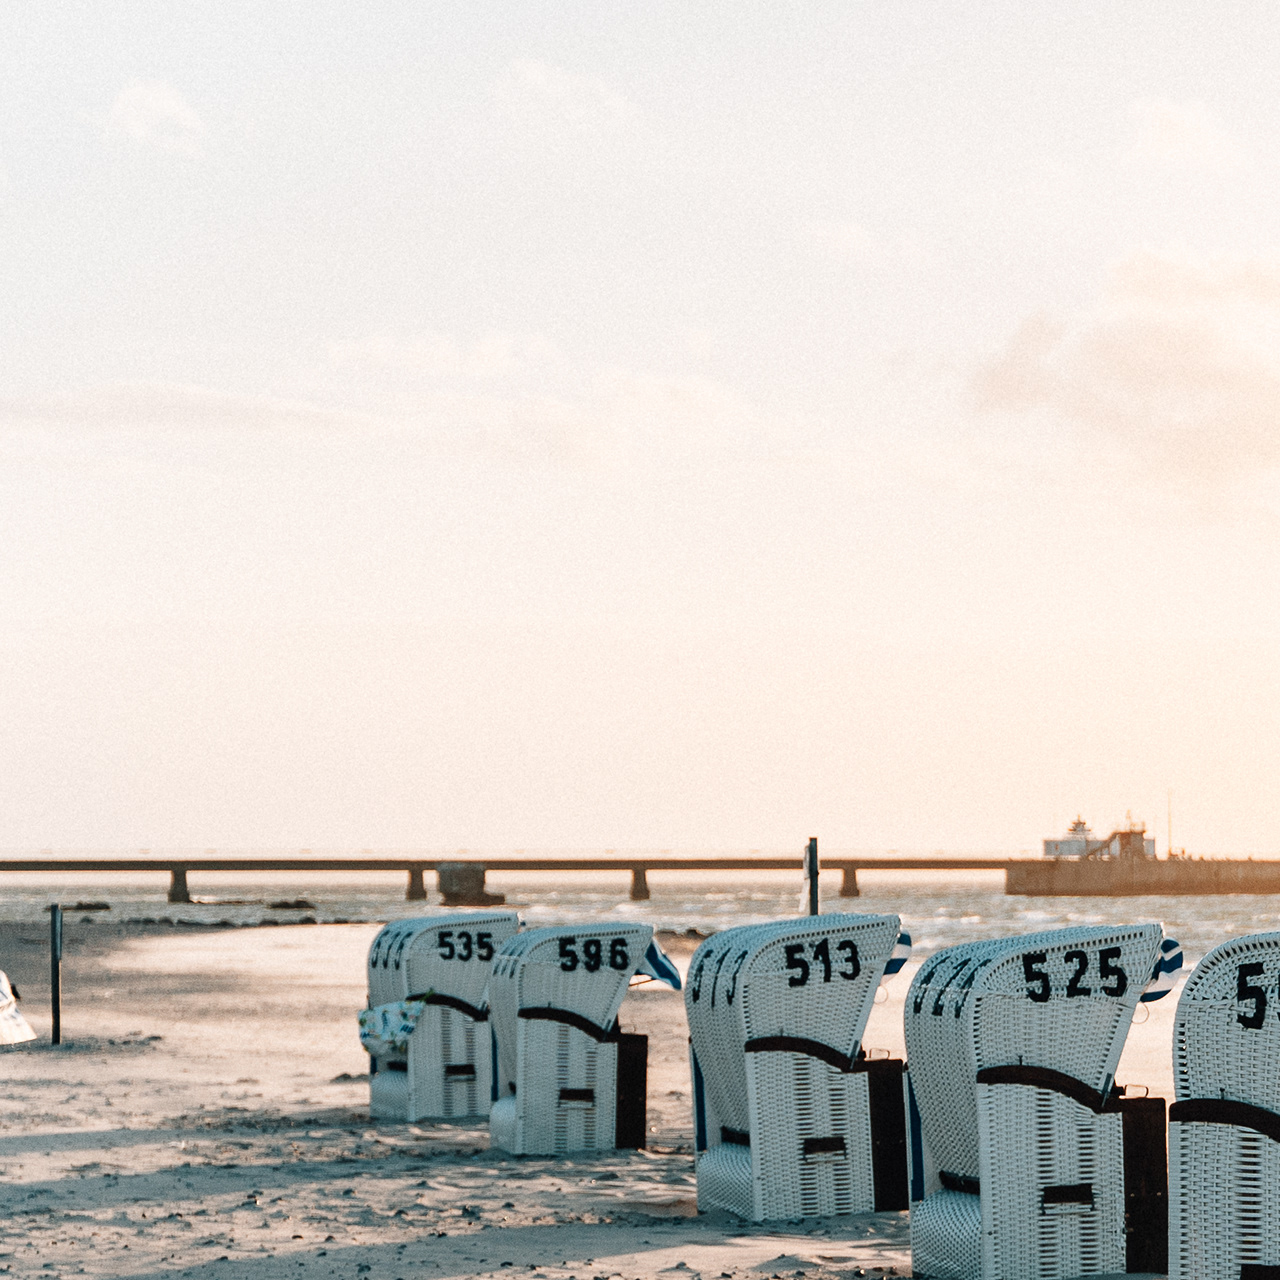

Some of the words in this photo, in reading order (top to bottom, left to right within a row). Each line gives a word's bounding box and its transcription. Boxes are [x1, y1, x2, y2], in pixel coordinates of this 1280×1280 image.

[438, 931, 496, 961] 535
[559, 936, 629, 972] 596
[784, 938, 861, 987] 513
[1022, 947, 1128, 1002] 525
